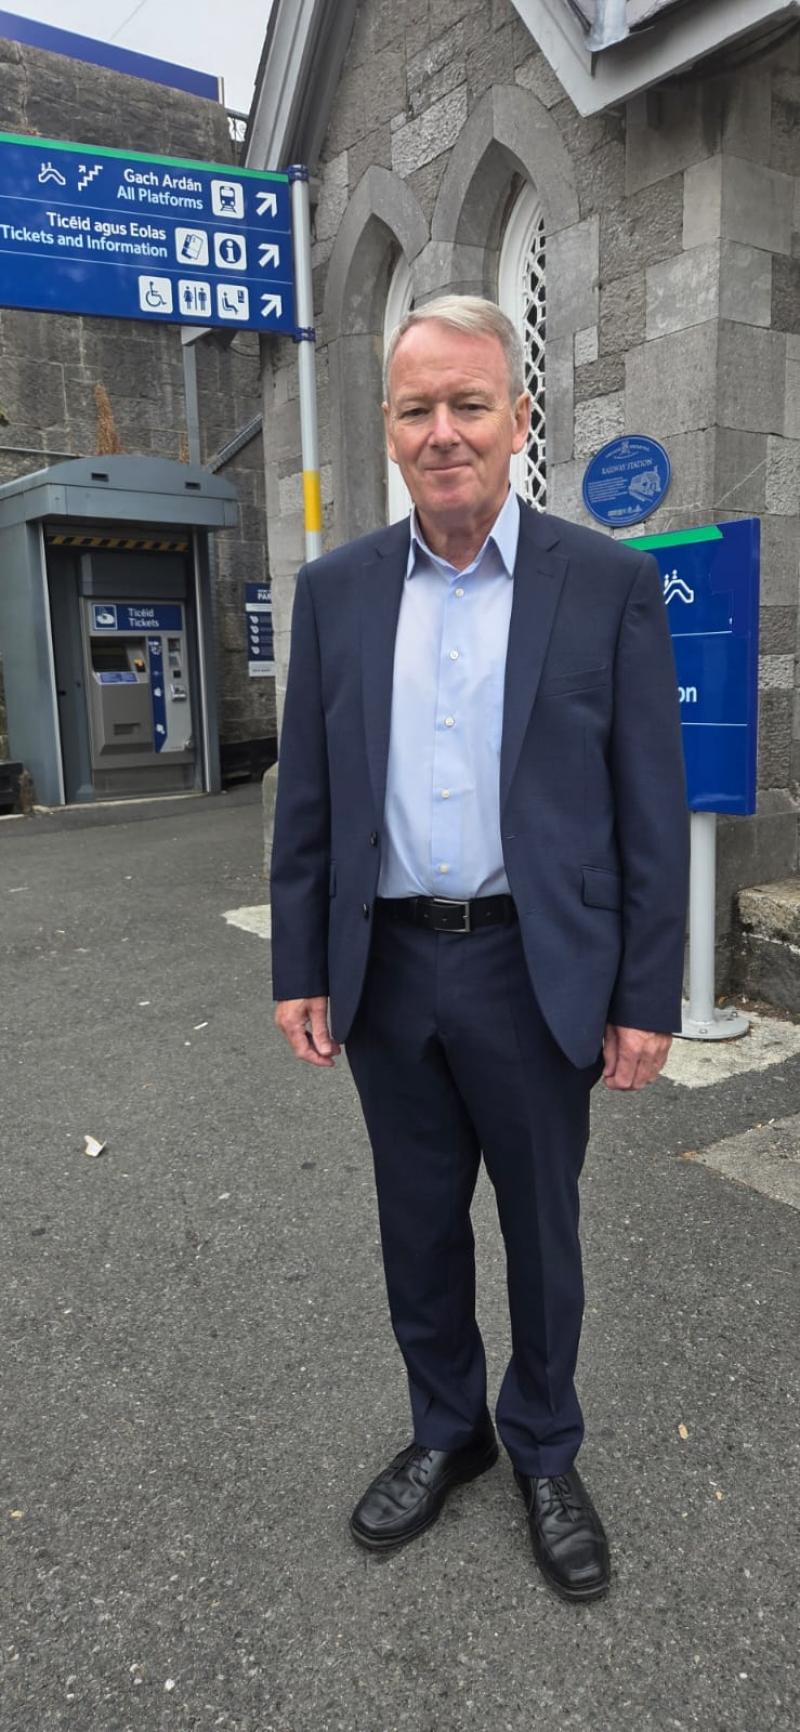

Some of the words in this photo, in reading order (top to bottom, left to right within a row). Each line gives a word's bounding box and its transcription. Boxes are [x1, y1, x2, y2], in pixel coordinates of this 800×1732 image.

[124, 169, 159, 186] Gach
[162, 174, 202, 192] Ardán
[117, 186, 135, 201] All
[138, 189, 203, 210] Platforms
[46, 212, 90, 231] Ticéid
[94, 221, 127, 237] agus
[130, 225, 166, 240] Eolas
[0, 224, 54, 244] Tickets
[57, 231, 83, 248] and
[87, 236, 168, 258] Information
[128, 607, 154, 618] Ticéid
[129, 618, 160, 628] Tickets
[677, 686, 697, 703] on
